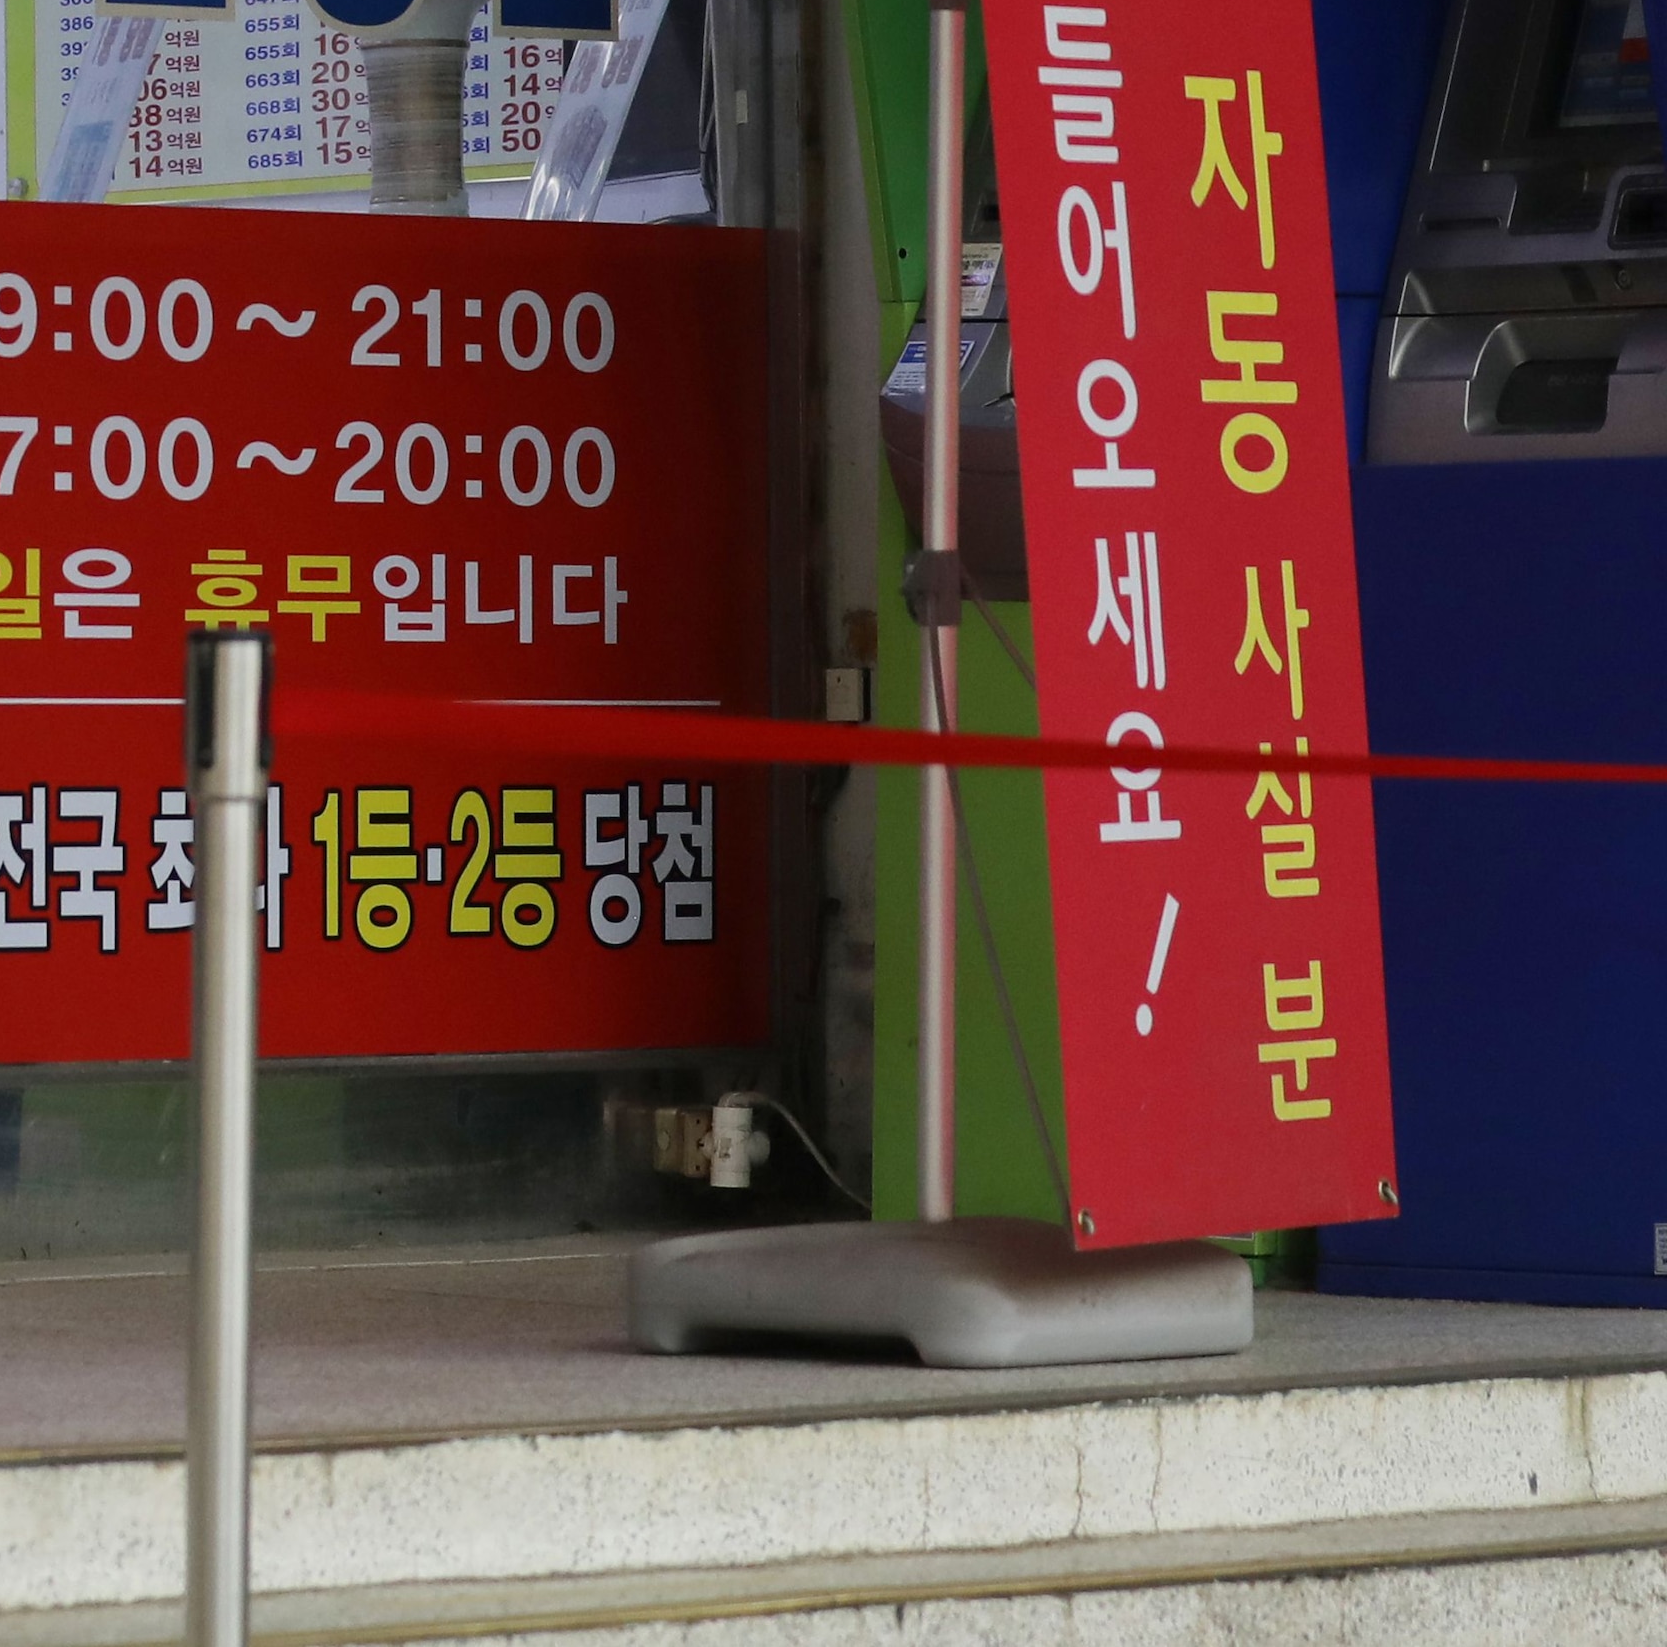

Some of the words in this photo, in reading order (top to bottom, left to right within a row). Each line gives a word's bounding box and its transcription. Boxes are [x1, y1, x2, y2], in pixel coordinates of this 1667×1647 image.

[244, 14, 300, 33] 655회
[244, 41, 300, 61] 655회
[245, 69, 301, 89] 663회
[245, 97, 301, 116] 668회
[246, 124, 303, 144] 674회
[248, 150, 304, 169] 685회
[185, 548, 629, 645] 휴무입니다
[1184, 70, 1298, 494] 자동
[1258, 960, 1337, 1122] 분
[584, 781, 717, 947] 당첨
